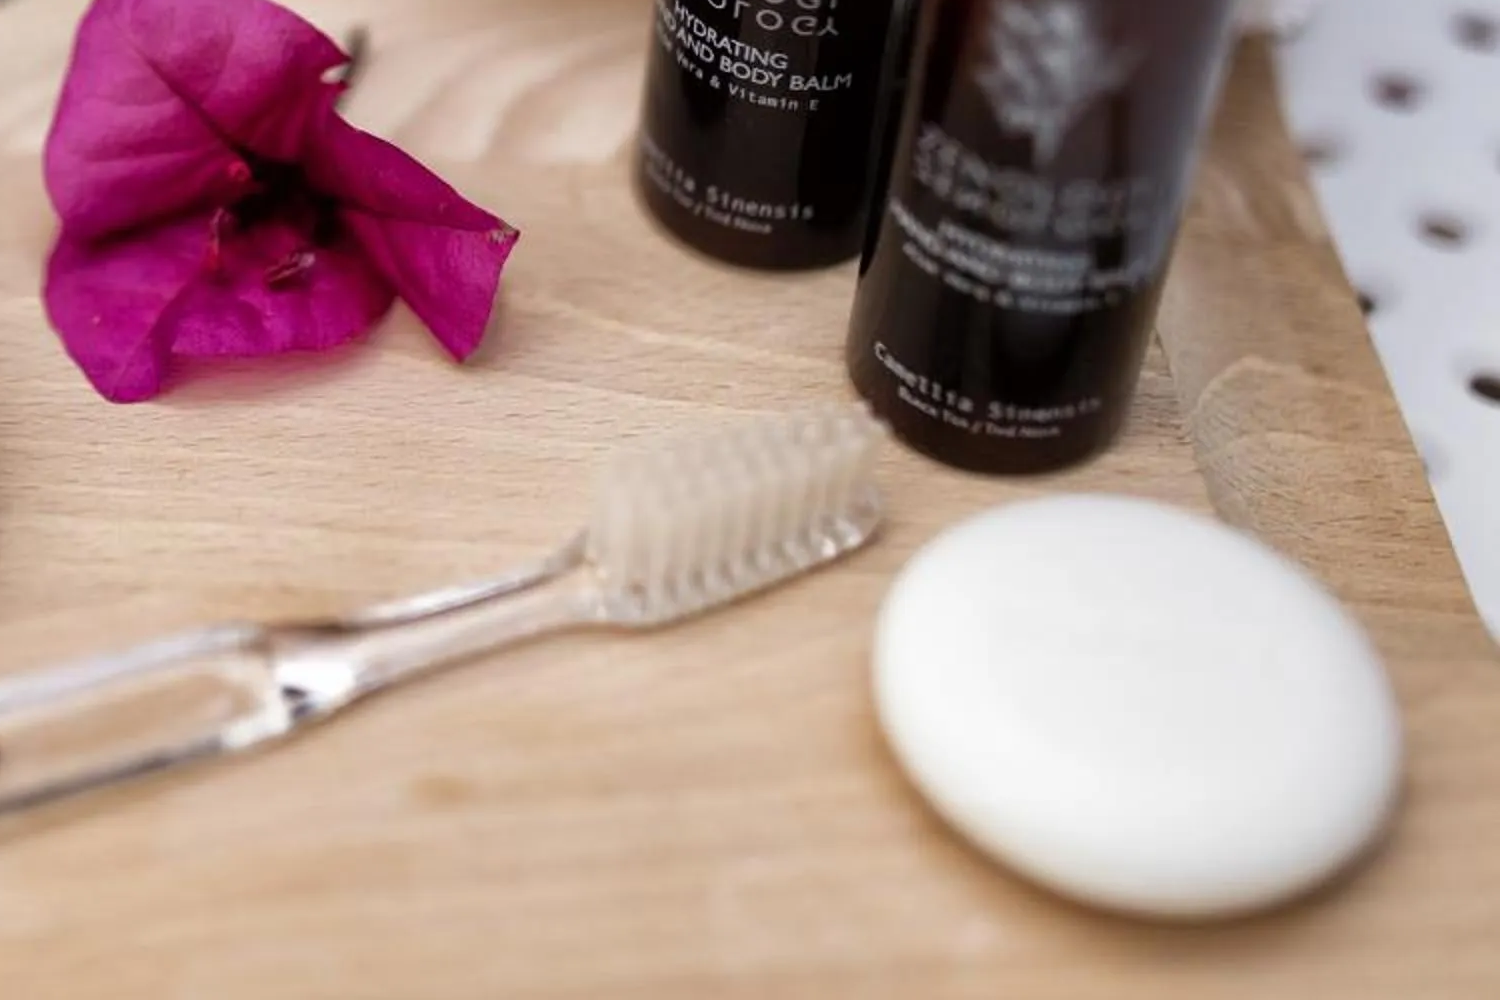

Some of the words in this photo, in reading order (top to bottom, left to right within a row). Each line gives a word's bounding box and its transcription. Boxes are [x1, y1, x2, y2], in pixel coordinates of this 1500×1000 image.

[674, 0, 789, 71] HYDRATING
[676, 26, 715, 64] AND
[719, 54, 784, 88] BODY
[789, 72, 852, 92] BALM
[809, 99, 820, 111] E
